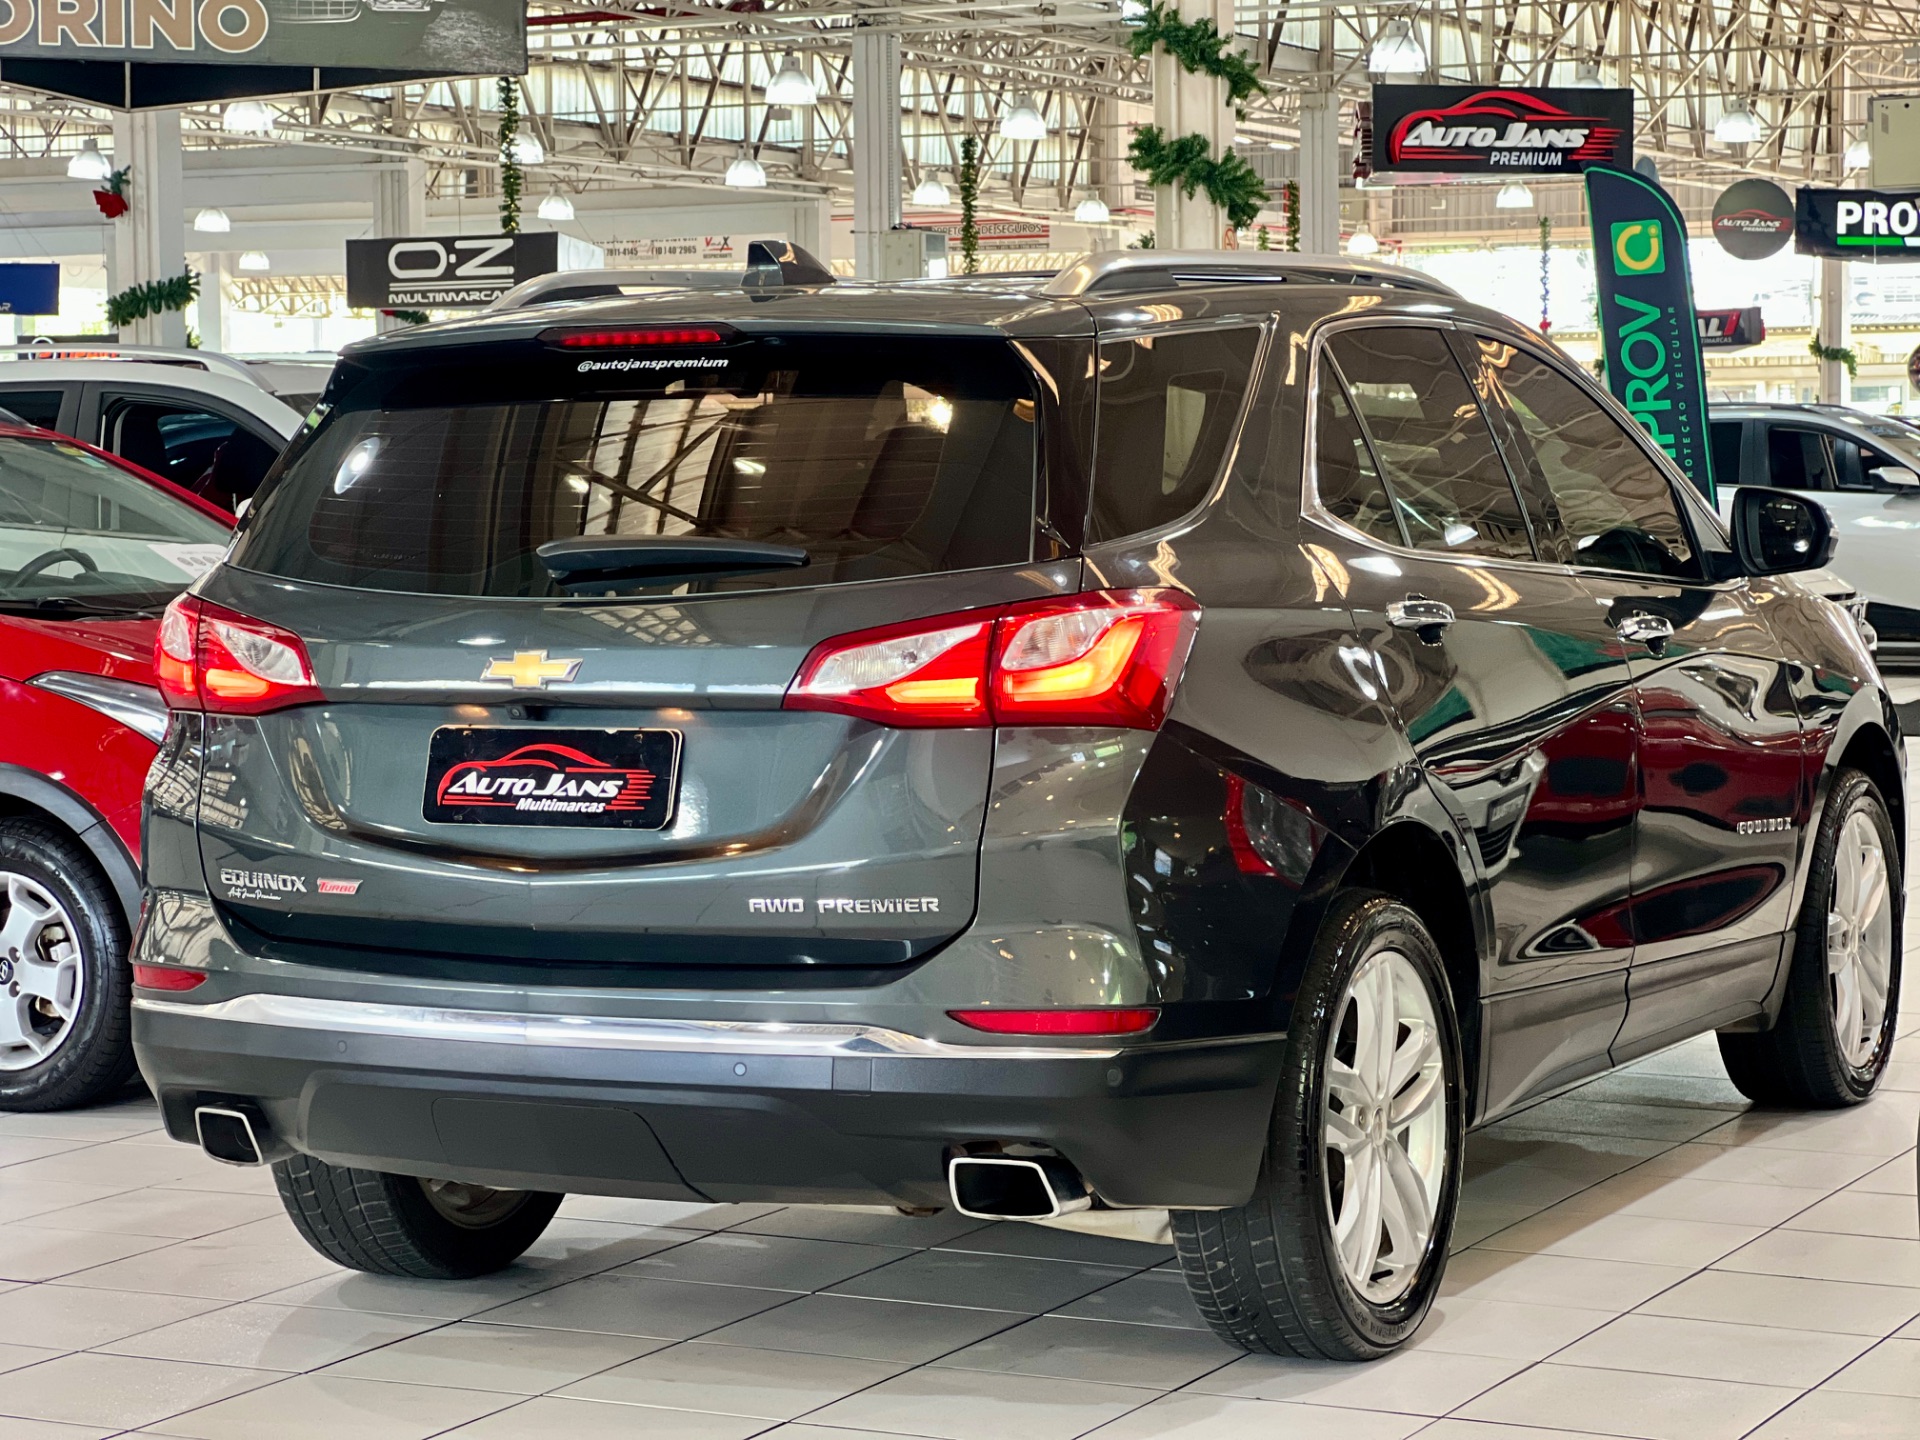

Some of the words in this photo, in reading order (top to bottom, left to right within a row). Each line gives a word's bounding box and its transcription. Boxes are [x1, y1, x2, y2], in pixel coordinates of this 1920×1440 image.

[1489, 151, 1562, 166] PREMIUM
[1836, 201, 1920, 236] PRO
[996, 223, 1041, 233] SEGUROS
[388, 290, 507, 304] MULTIMARCA
[1668, 306, 1685, 390] VEICULAR
[577, 357, 729, 372] @autojanspremium
[1678, 401, 1693, 478] ROTEÇÃO
[515, 797, 606, 813] Multimarcas
[1737, 817, 1792, 834] EQUINOX
[220, 868, 307, 893] EQUINOX
[749, 898, 804, 913] AWD
[817, 897, 939, 914] PREMIER
